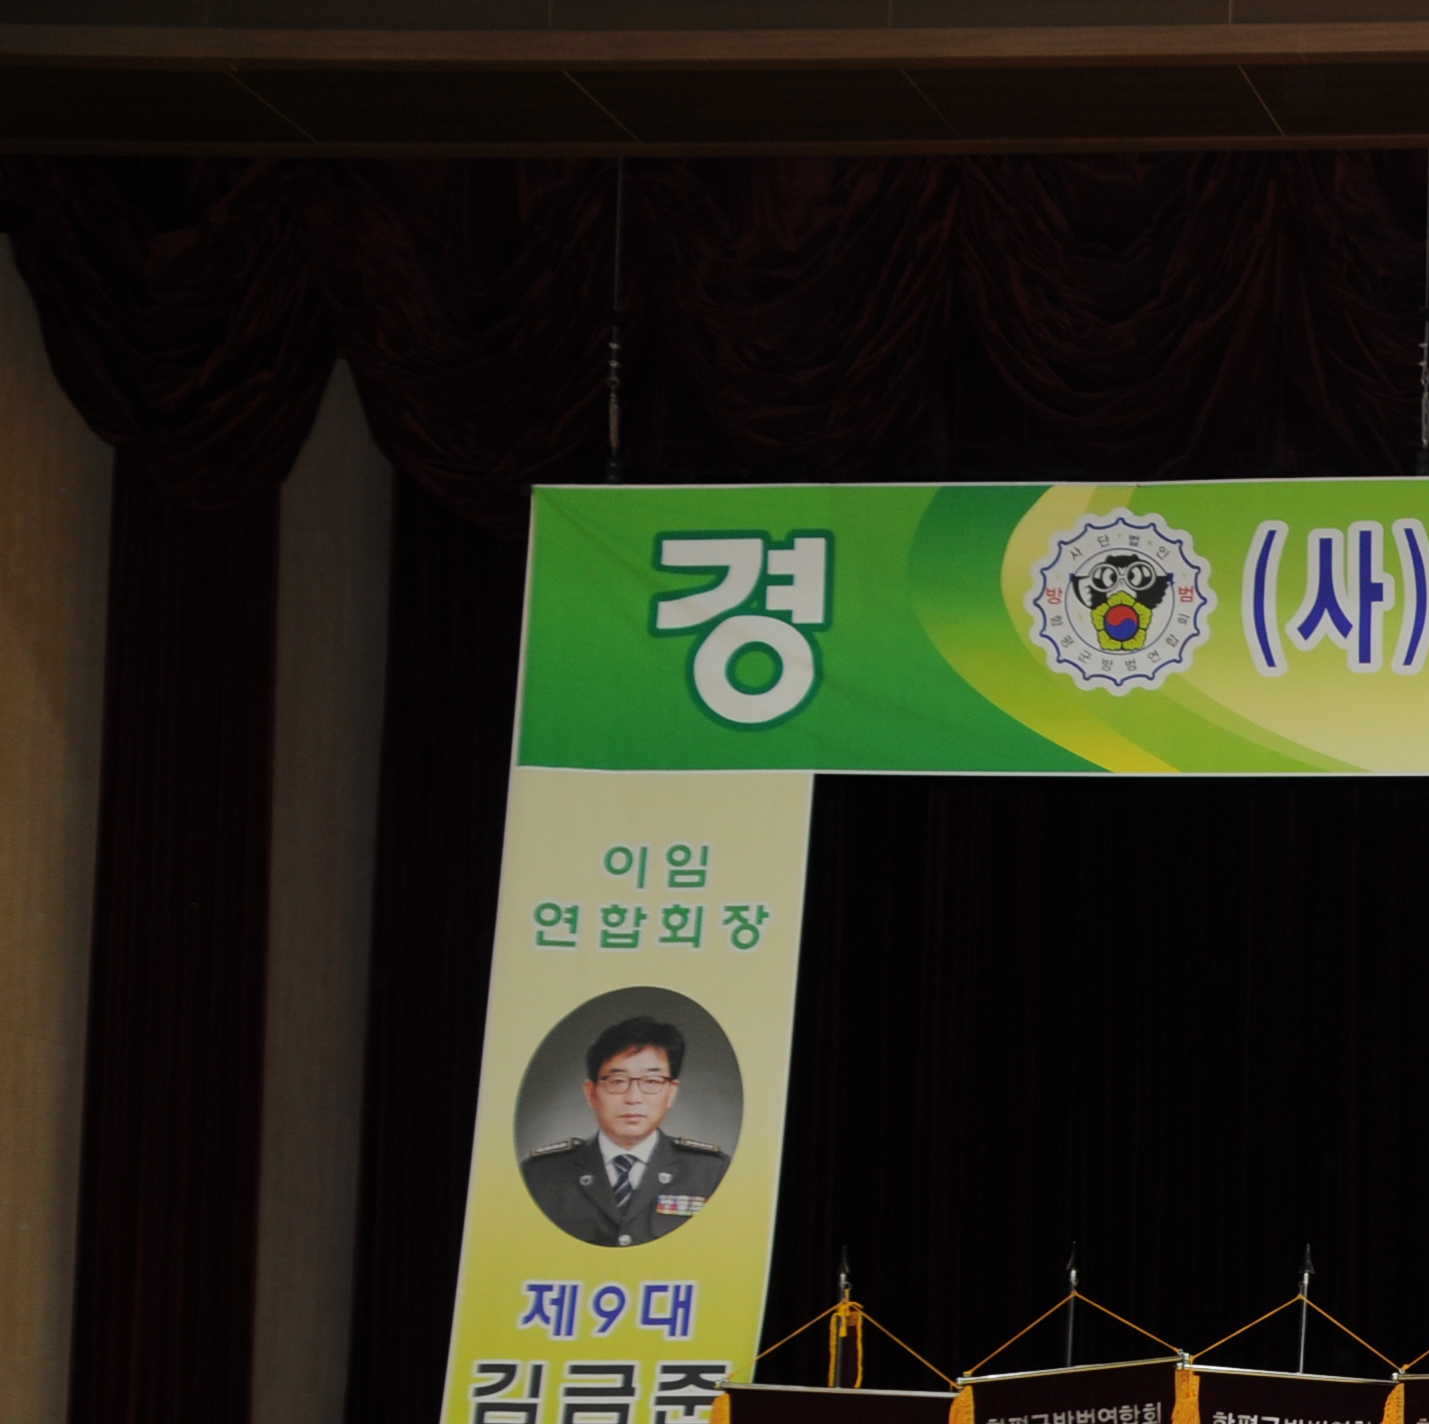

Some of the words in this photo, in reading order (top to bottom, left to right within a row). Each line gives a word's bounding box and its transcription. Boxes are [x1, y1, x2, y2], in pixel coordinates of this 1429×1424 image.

[655, 533, 827, 725] 경
[602, 843, 712, 889] 이임
[533, 901, 770, 950] 연합회장
[519, 1281, 696, 1339] 제9대
